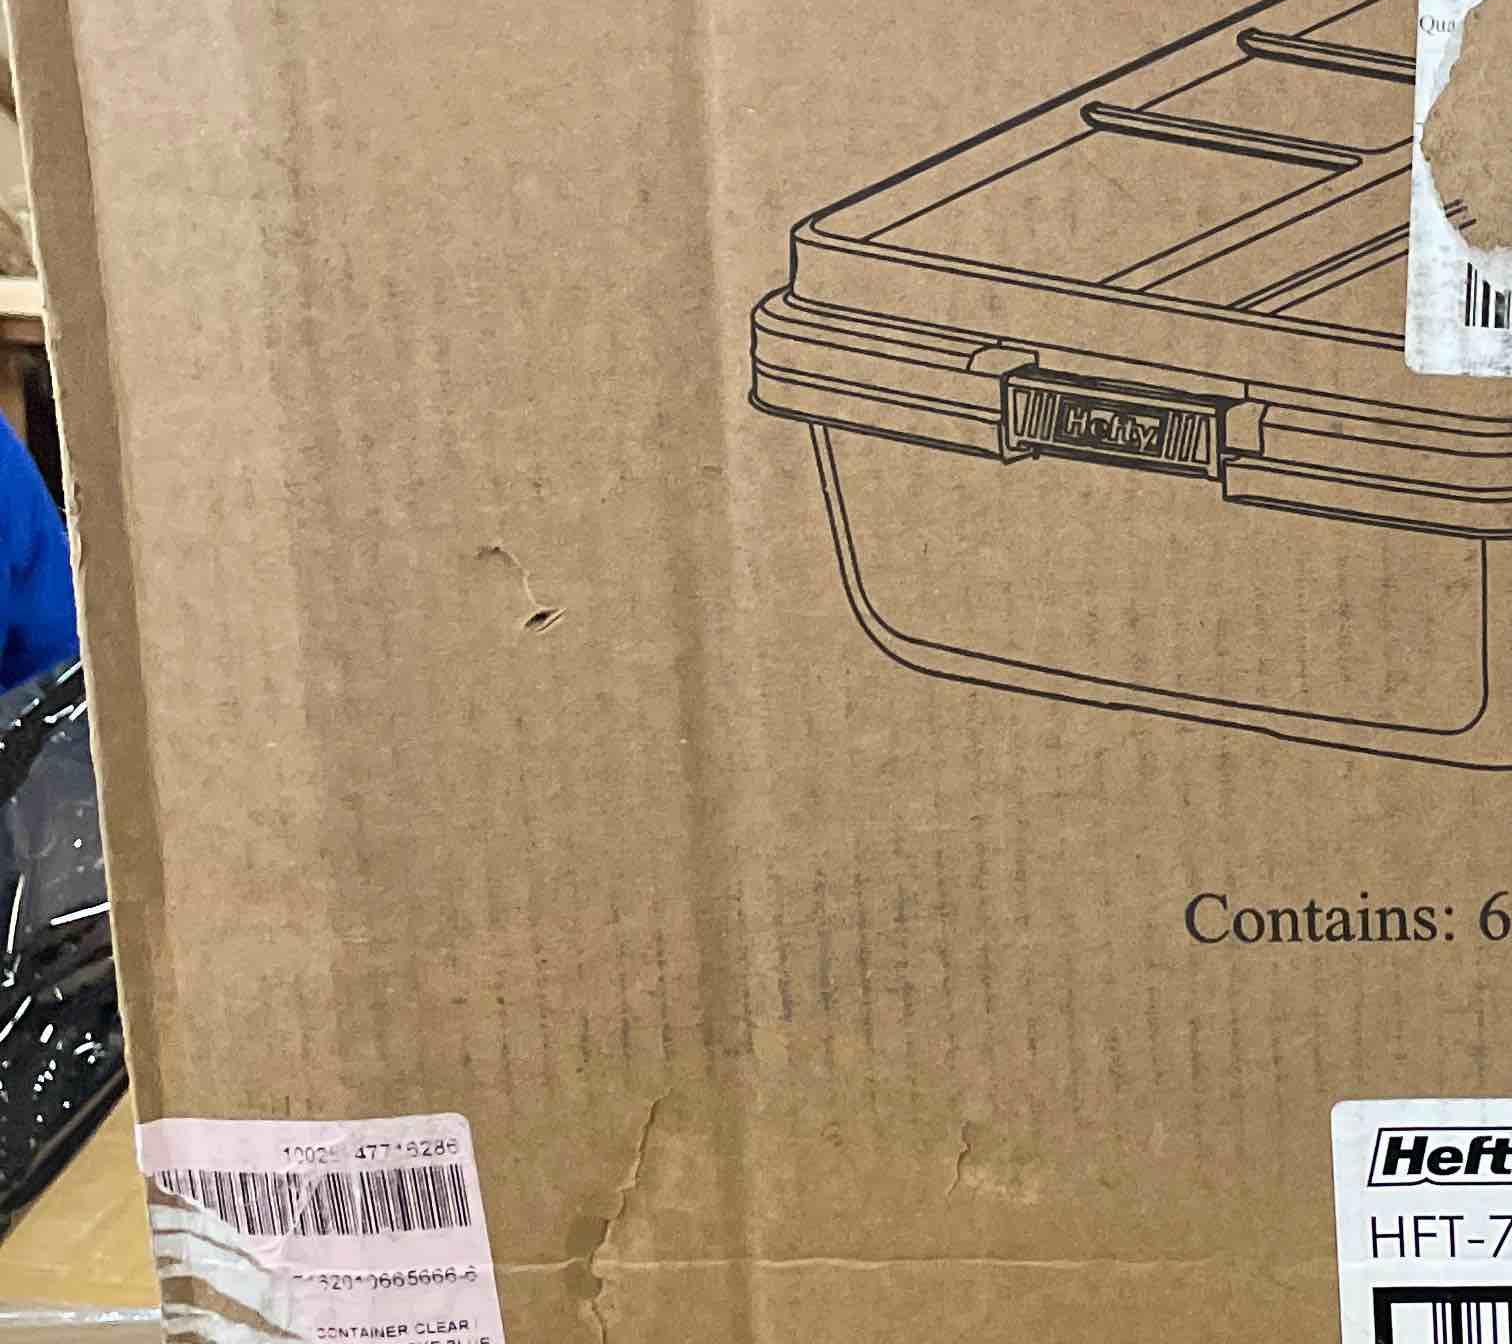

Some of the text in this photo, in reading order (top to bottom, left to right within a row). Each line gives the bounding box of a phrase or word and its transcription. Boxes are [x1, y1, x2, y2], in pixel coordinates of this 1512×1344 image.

[1419, 15, 1456, 36] Qua
[1184, 891, 1455, 945] Contains:
[1479, 891, 1511, 941] 6
[318, 1319, 469, 1340] CONTAINER CLEAR
